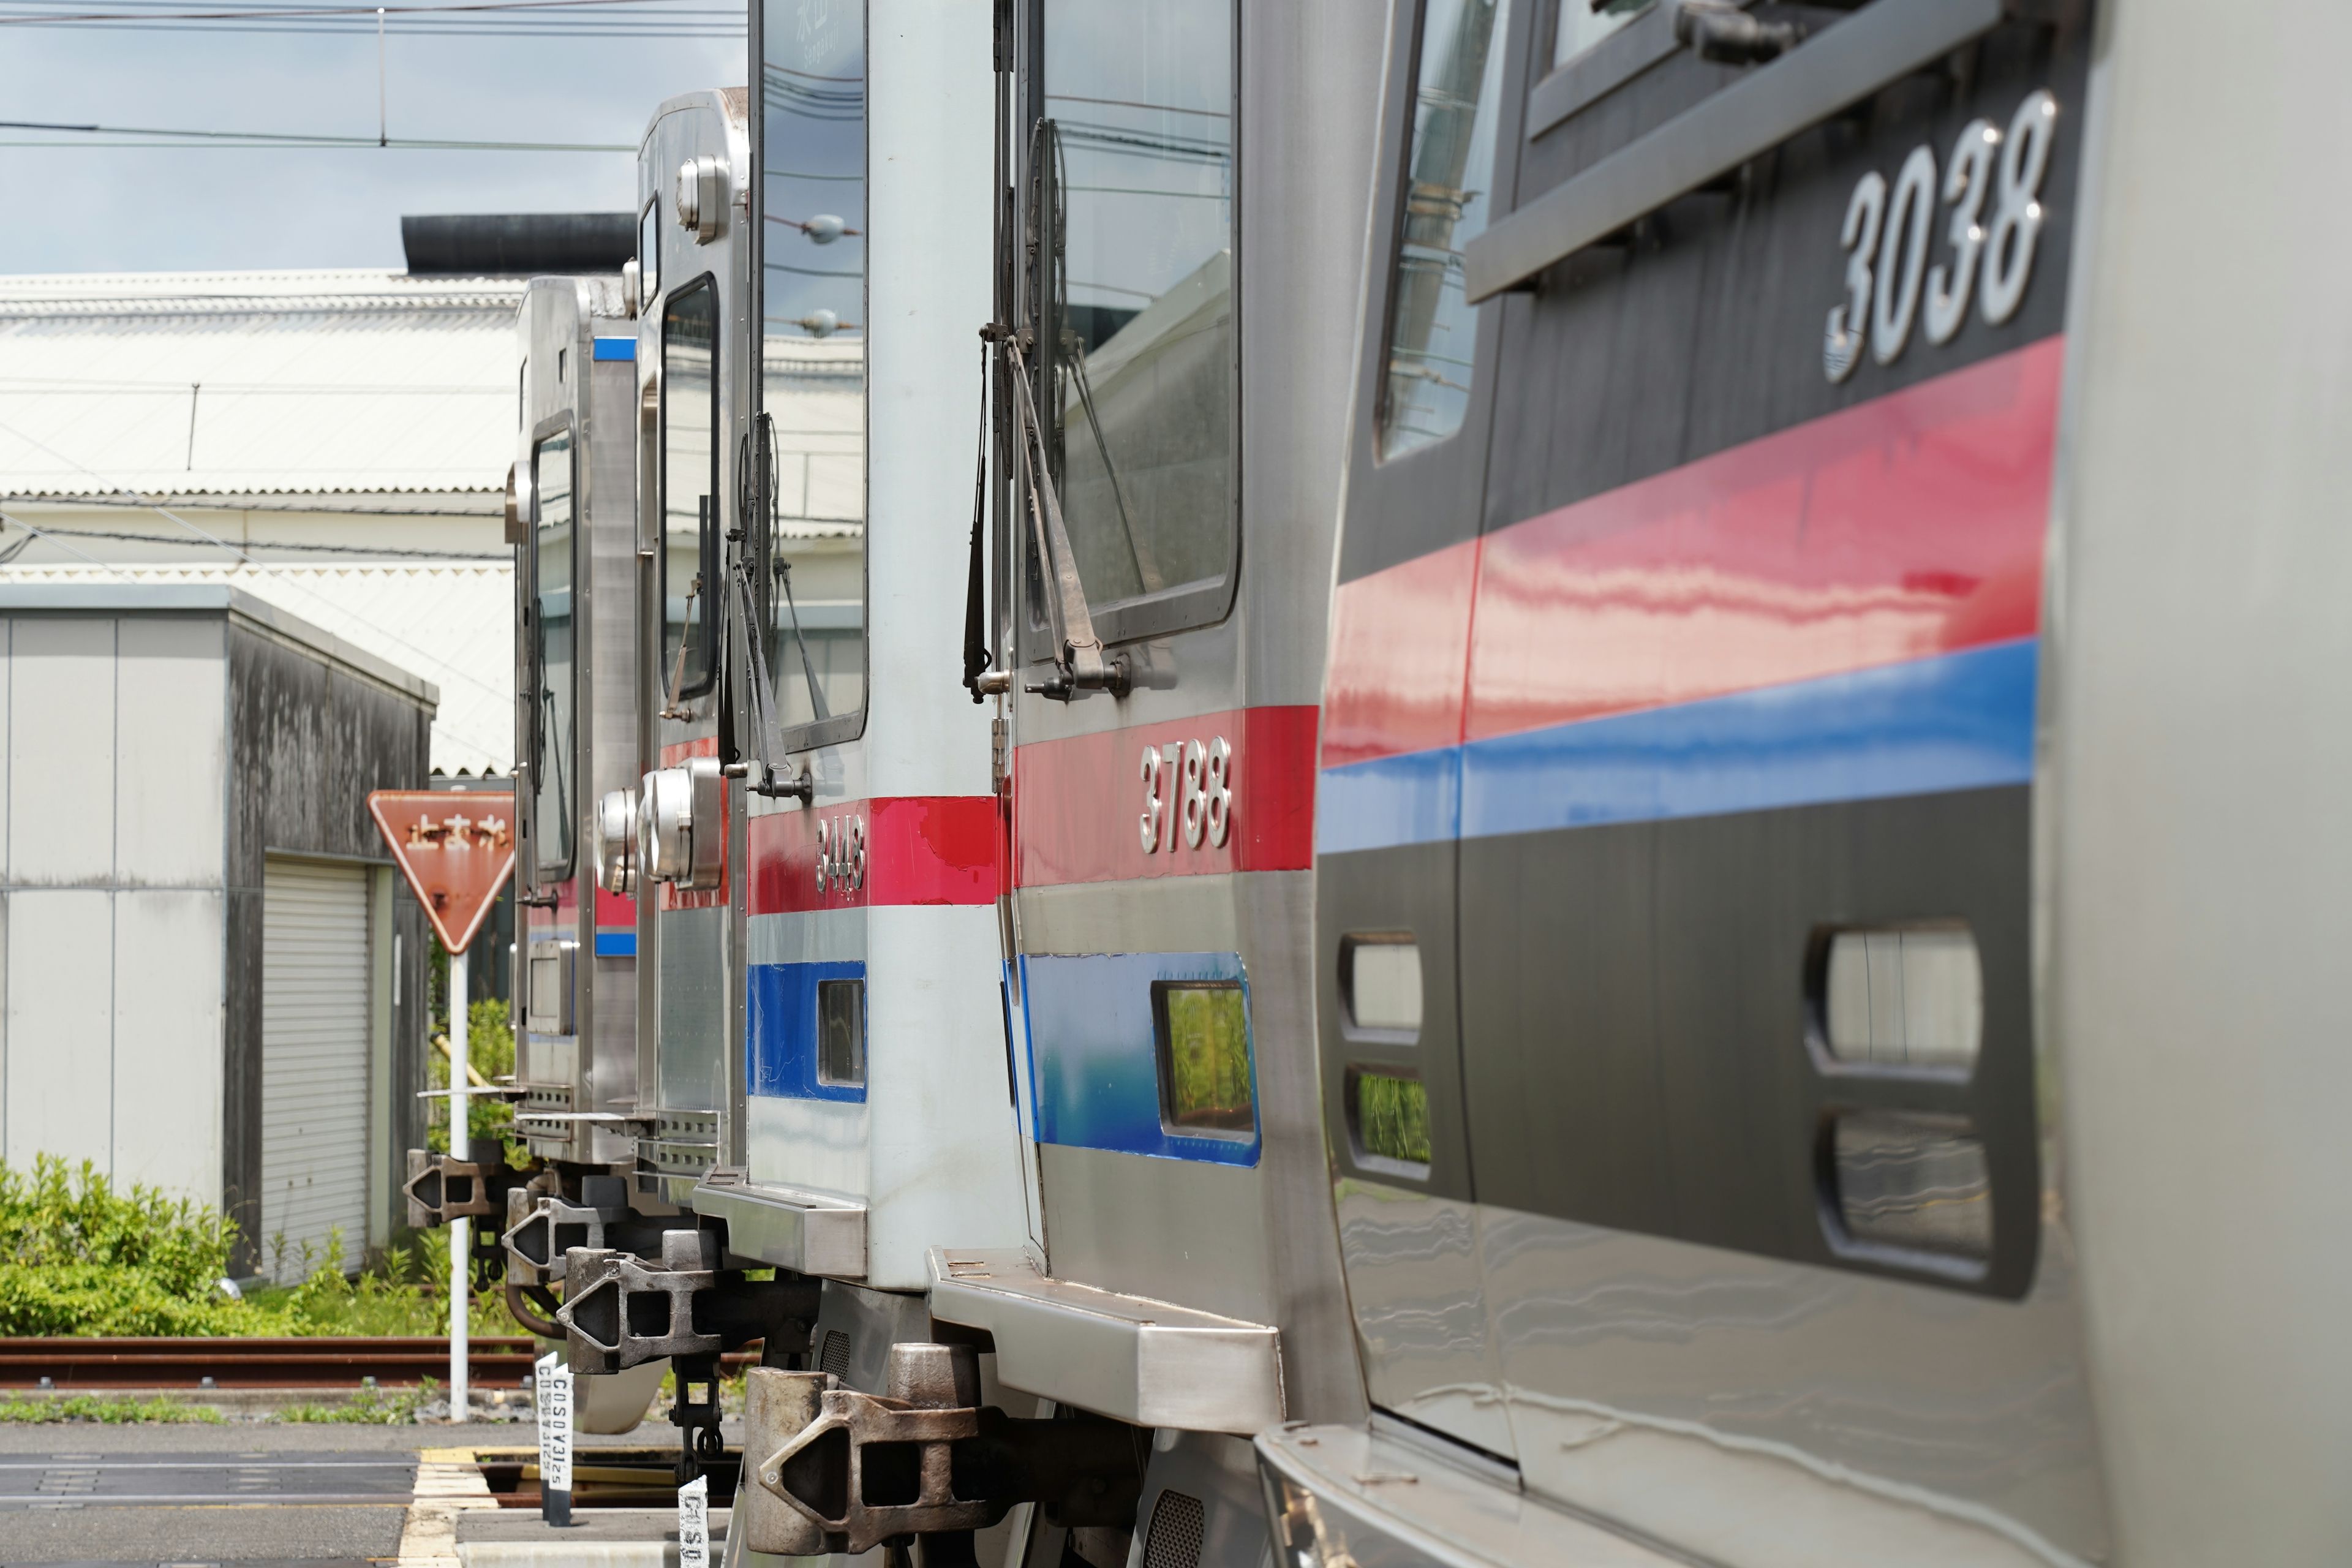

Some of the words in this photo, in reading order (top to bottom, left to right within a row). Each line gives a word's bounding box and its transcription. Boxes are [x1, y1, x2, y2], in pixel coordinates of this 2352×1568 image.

[804, 20, 839, 69] Sengakuji
[1823, 88, 2059, 383] 3038
[406, 813, 510, 851] 止まれ
[1139, 735, 1232, 854] 3788
[816, 814, 865, 894] 3448
